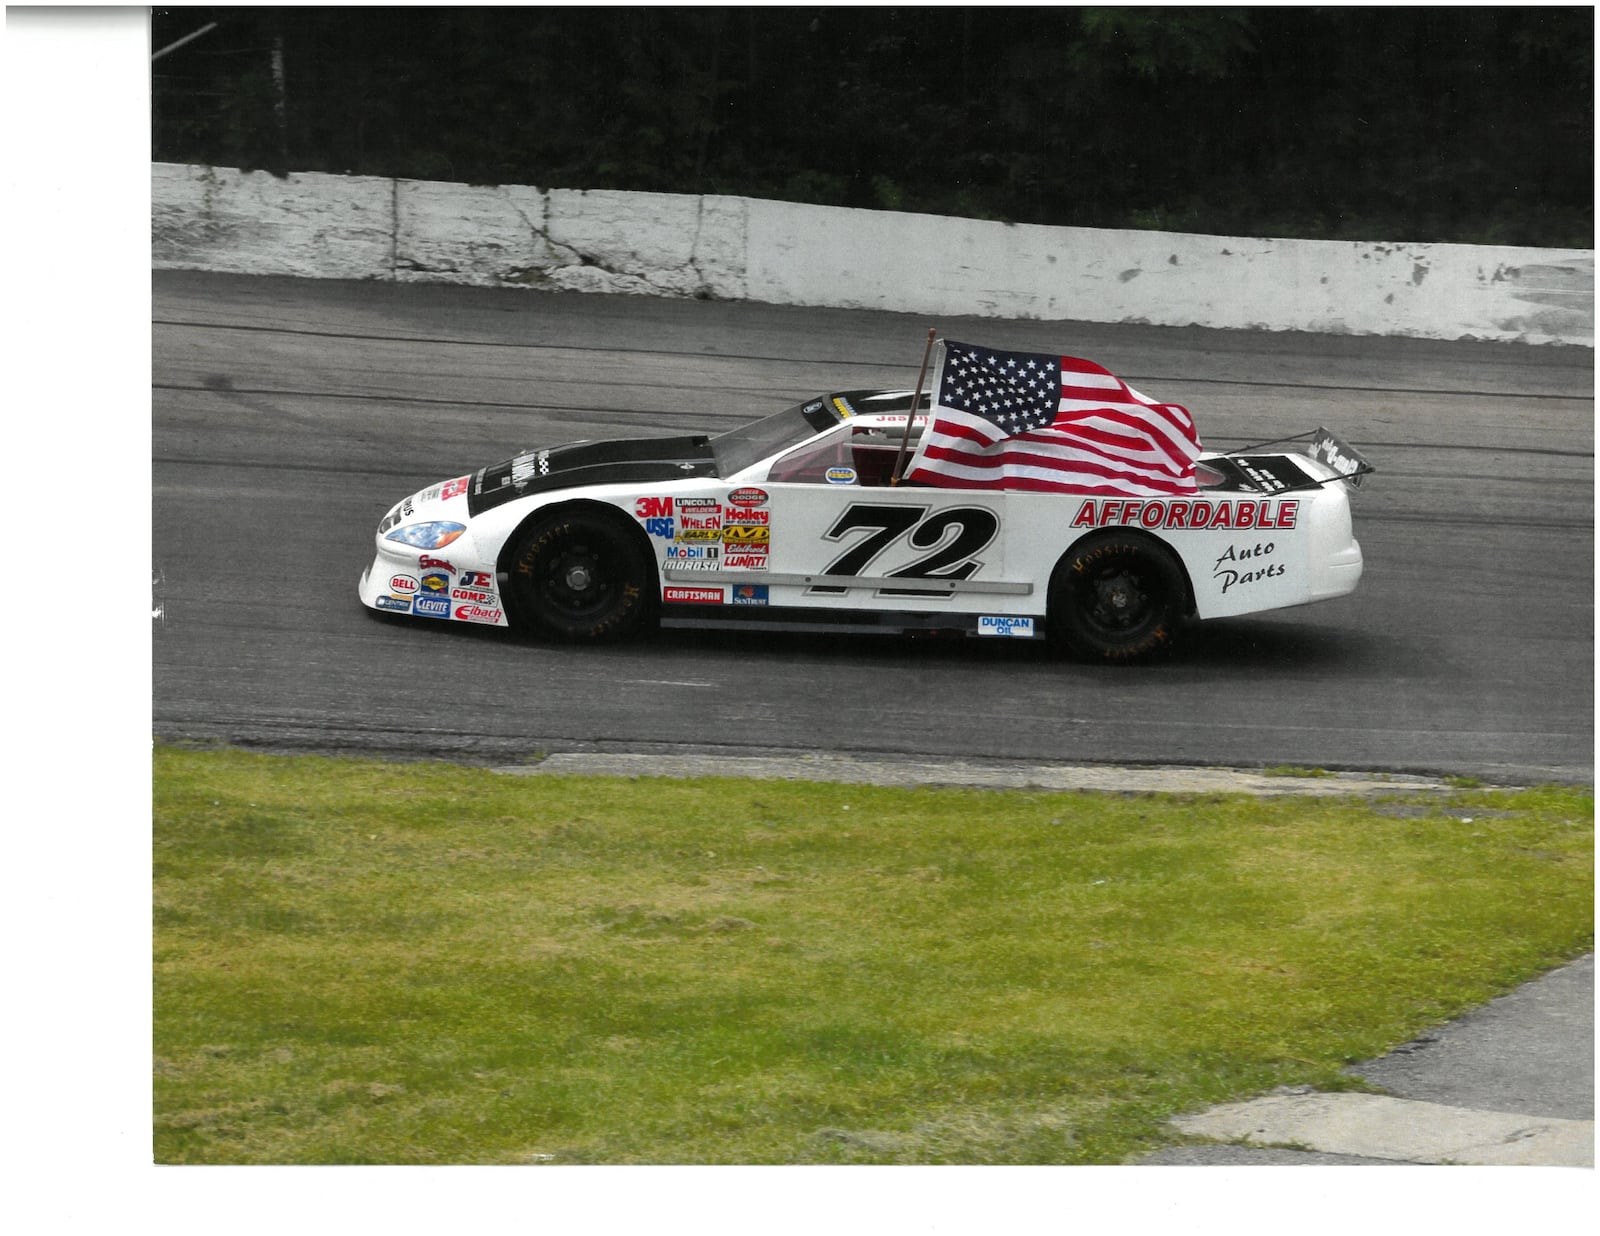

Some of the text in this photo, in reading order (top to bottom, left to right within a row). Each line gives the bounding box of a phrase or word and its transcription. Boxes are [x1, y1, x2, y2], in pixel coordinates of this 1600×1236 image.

[636, 497, 674, 517] 3M
[1070, 499, 1300, 530] AFFORDABLE
[680, 515, 721, 529] WHELEN
[725, 508, 769, 524] Holley
[646, 518, 675, 539] USG
[667, 547, 719, 558] Mobil 1
[802, 501, 1001, 600] 72
[1213, 541, 1276, 572] Auto
[723, 555, 767, 569] LUNATI
[392, 578, 415, 590] BELL
[459, 571, 492, 588] JE
[1213, 562, 1287, 595] Parts
[452, 589, 487, 602] COMP
[666, 589, 721, 601] CRAFTSMAN
[416, 597, 450, 613] CLEVITE
[455, 605, 502, 620] Eibach
[982, 617, 1029, 628] DUNCAN
[996, 626, 1013, 635] OIL
